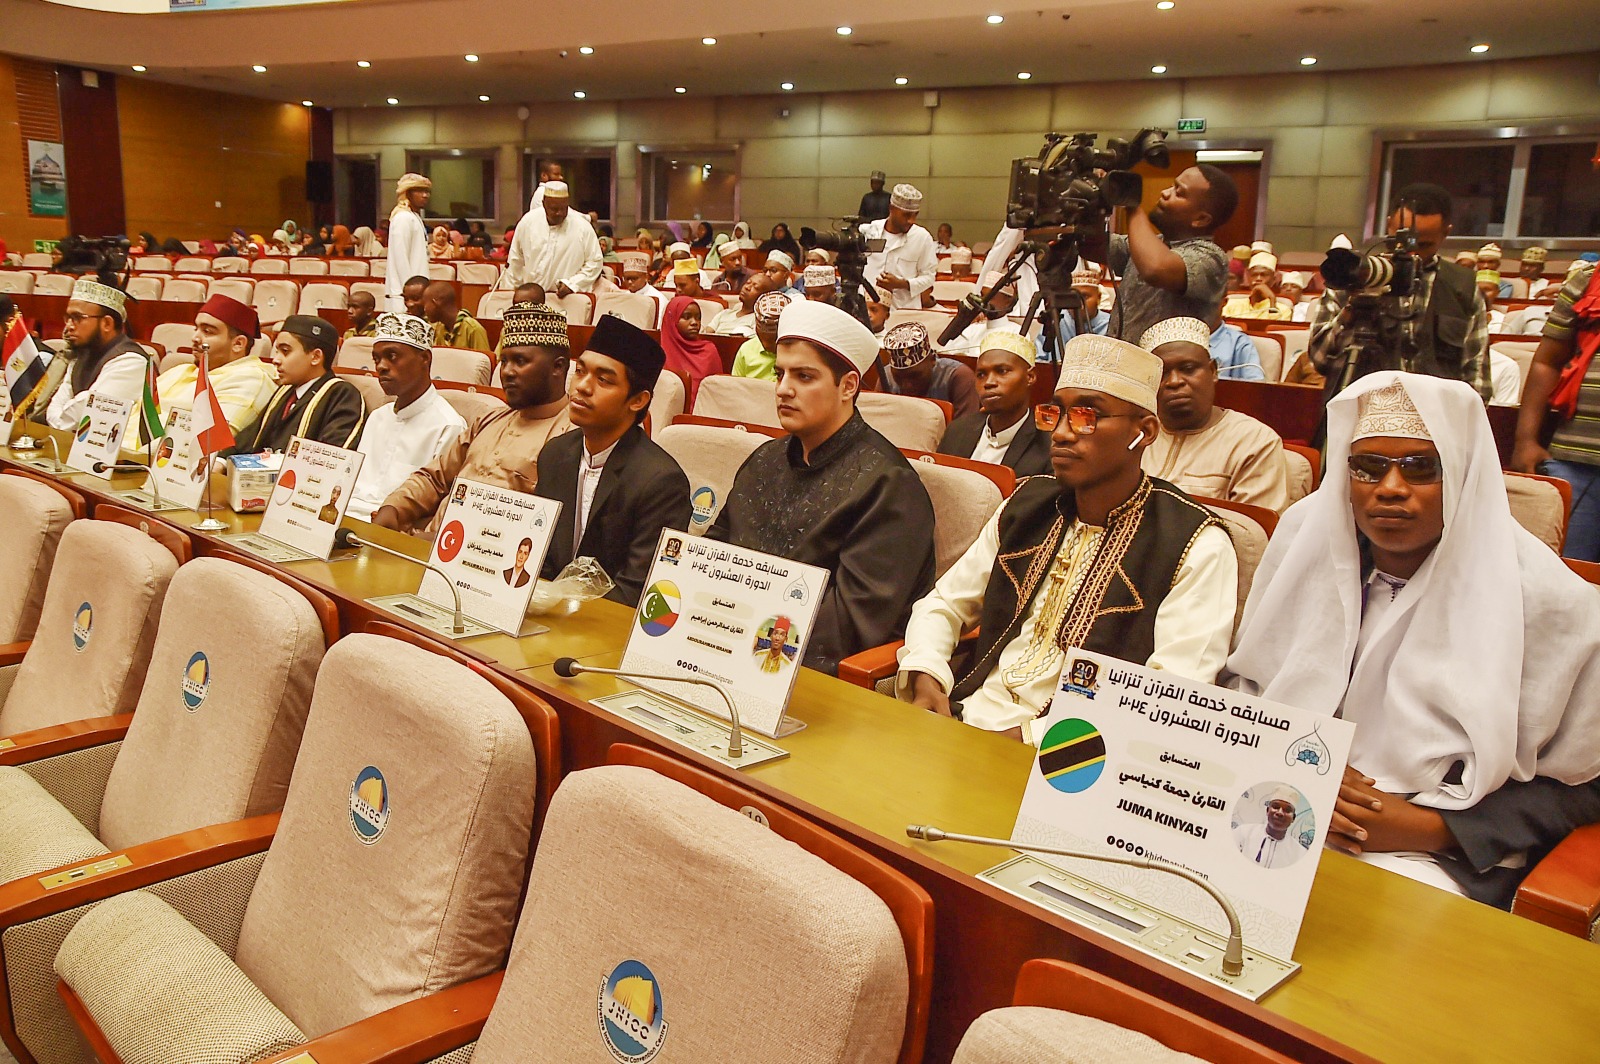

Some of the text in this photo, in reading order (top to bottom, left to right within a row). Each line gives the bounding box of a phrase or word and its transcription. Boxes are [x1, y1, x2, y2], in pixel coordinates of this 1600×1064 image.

[687, 543, 707, 556] تنزانيا
[732, 554, 754, 568] خدمة
[709, 567, 743, 583] العشرون
[745, 576, 771, 591] الدورة
[712, 598, 735, 609] المتسابق
[1076, 662, 1094, 680] 20
[1108, 668, 1290, 731] مسابقه خدمة القرآن تنزانيا
[1149, 704, 1211, 733] العشرون
[1215, 723, 1260, 748] الدورة
[1160, 752, 1200, 770] المتسابق
[1119, 772, 1226, 811] القارئ جمعة كنياسي
[1116, 798, 1208, 839] JUMA KINYASI
[630, 1047, 656, 1063] Convention
[655, 1024, 666, 1047] Centre
